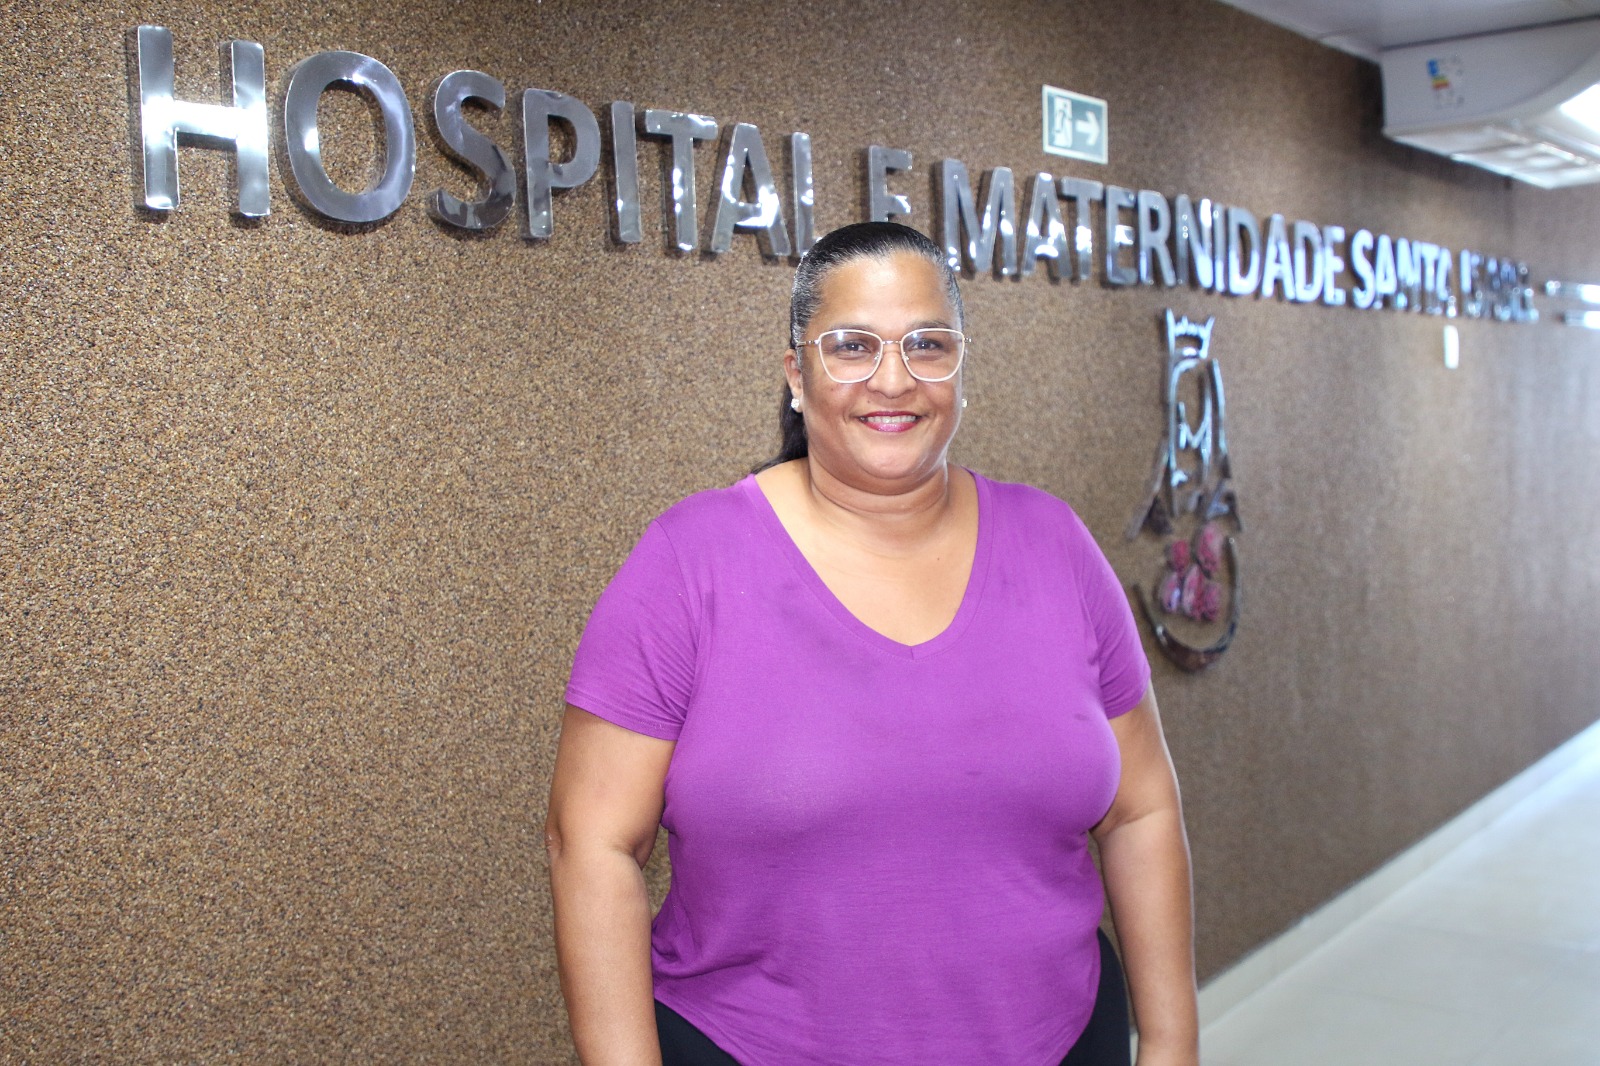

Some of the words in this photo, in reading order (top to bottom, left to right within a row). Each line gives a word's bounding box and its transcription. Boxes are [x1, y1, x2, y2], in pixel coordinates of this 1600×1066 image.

[136, 25, 822, 257] HOSPITAL
[942, 158, 1347, 305] MATERNIDADE
[1351, 229, 1457, 318] SANTA
